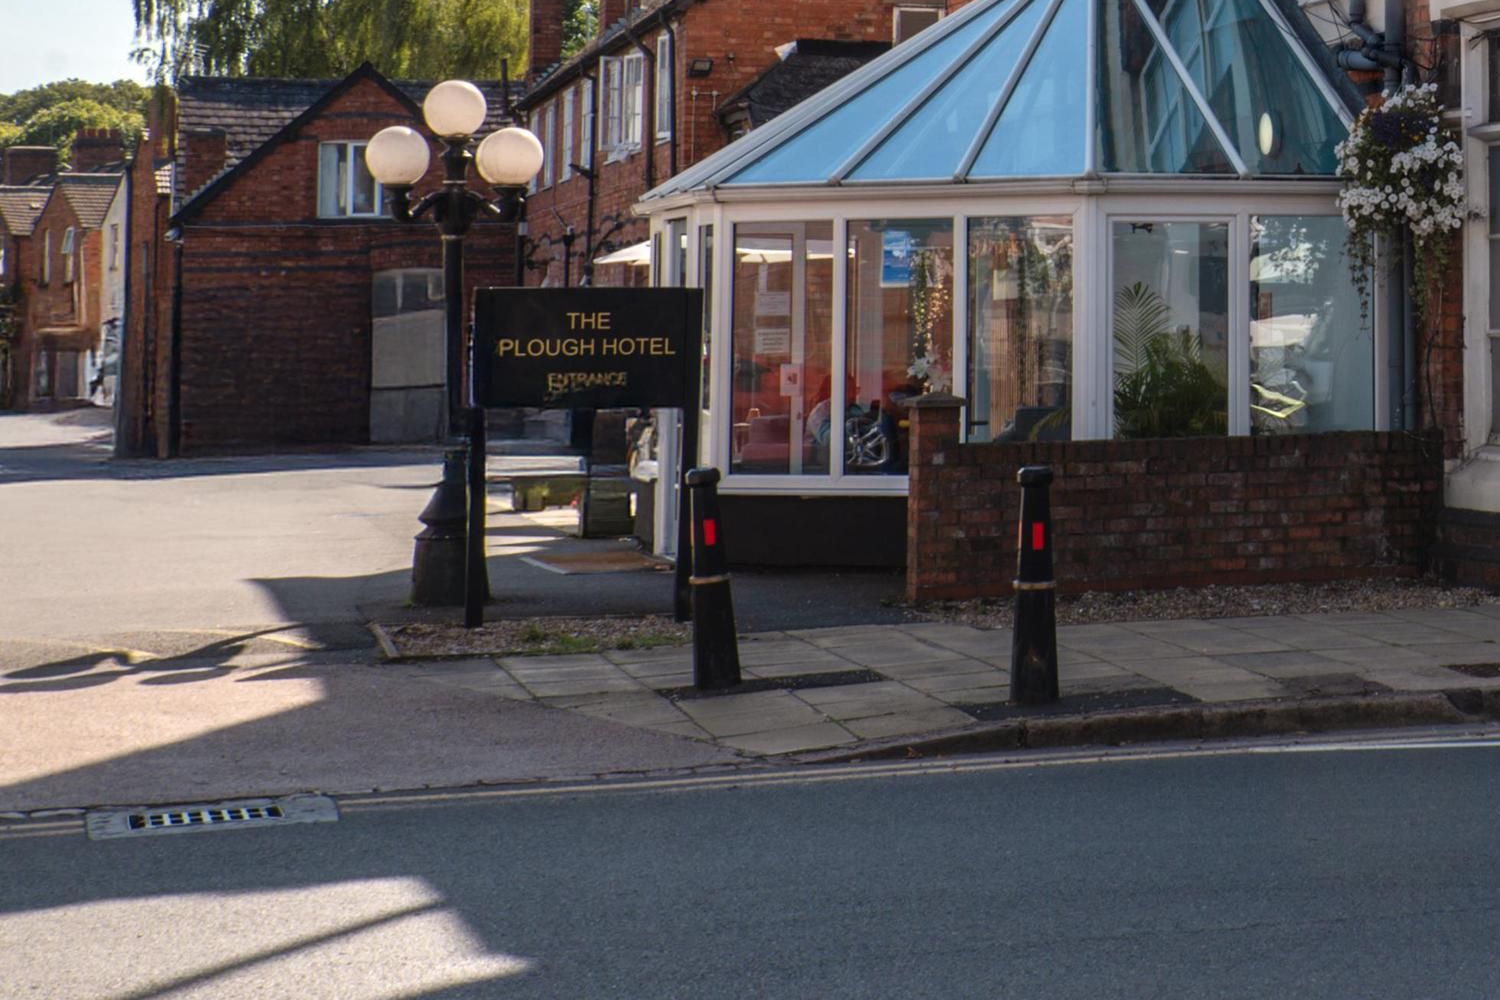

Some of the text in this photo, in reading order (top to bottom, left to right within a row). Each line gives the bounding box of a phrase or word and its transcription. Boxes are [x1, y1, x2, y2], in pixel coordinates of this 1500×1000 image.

[566, 312, 611, 330] THE
[497, 337, 676, 357] PLOUGH HOTEL
[547, 372, 628, 390] ENTRANCE
